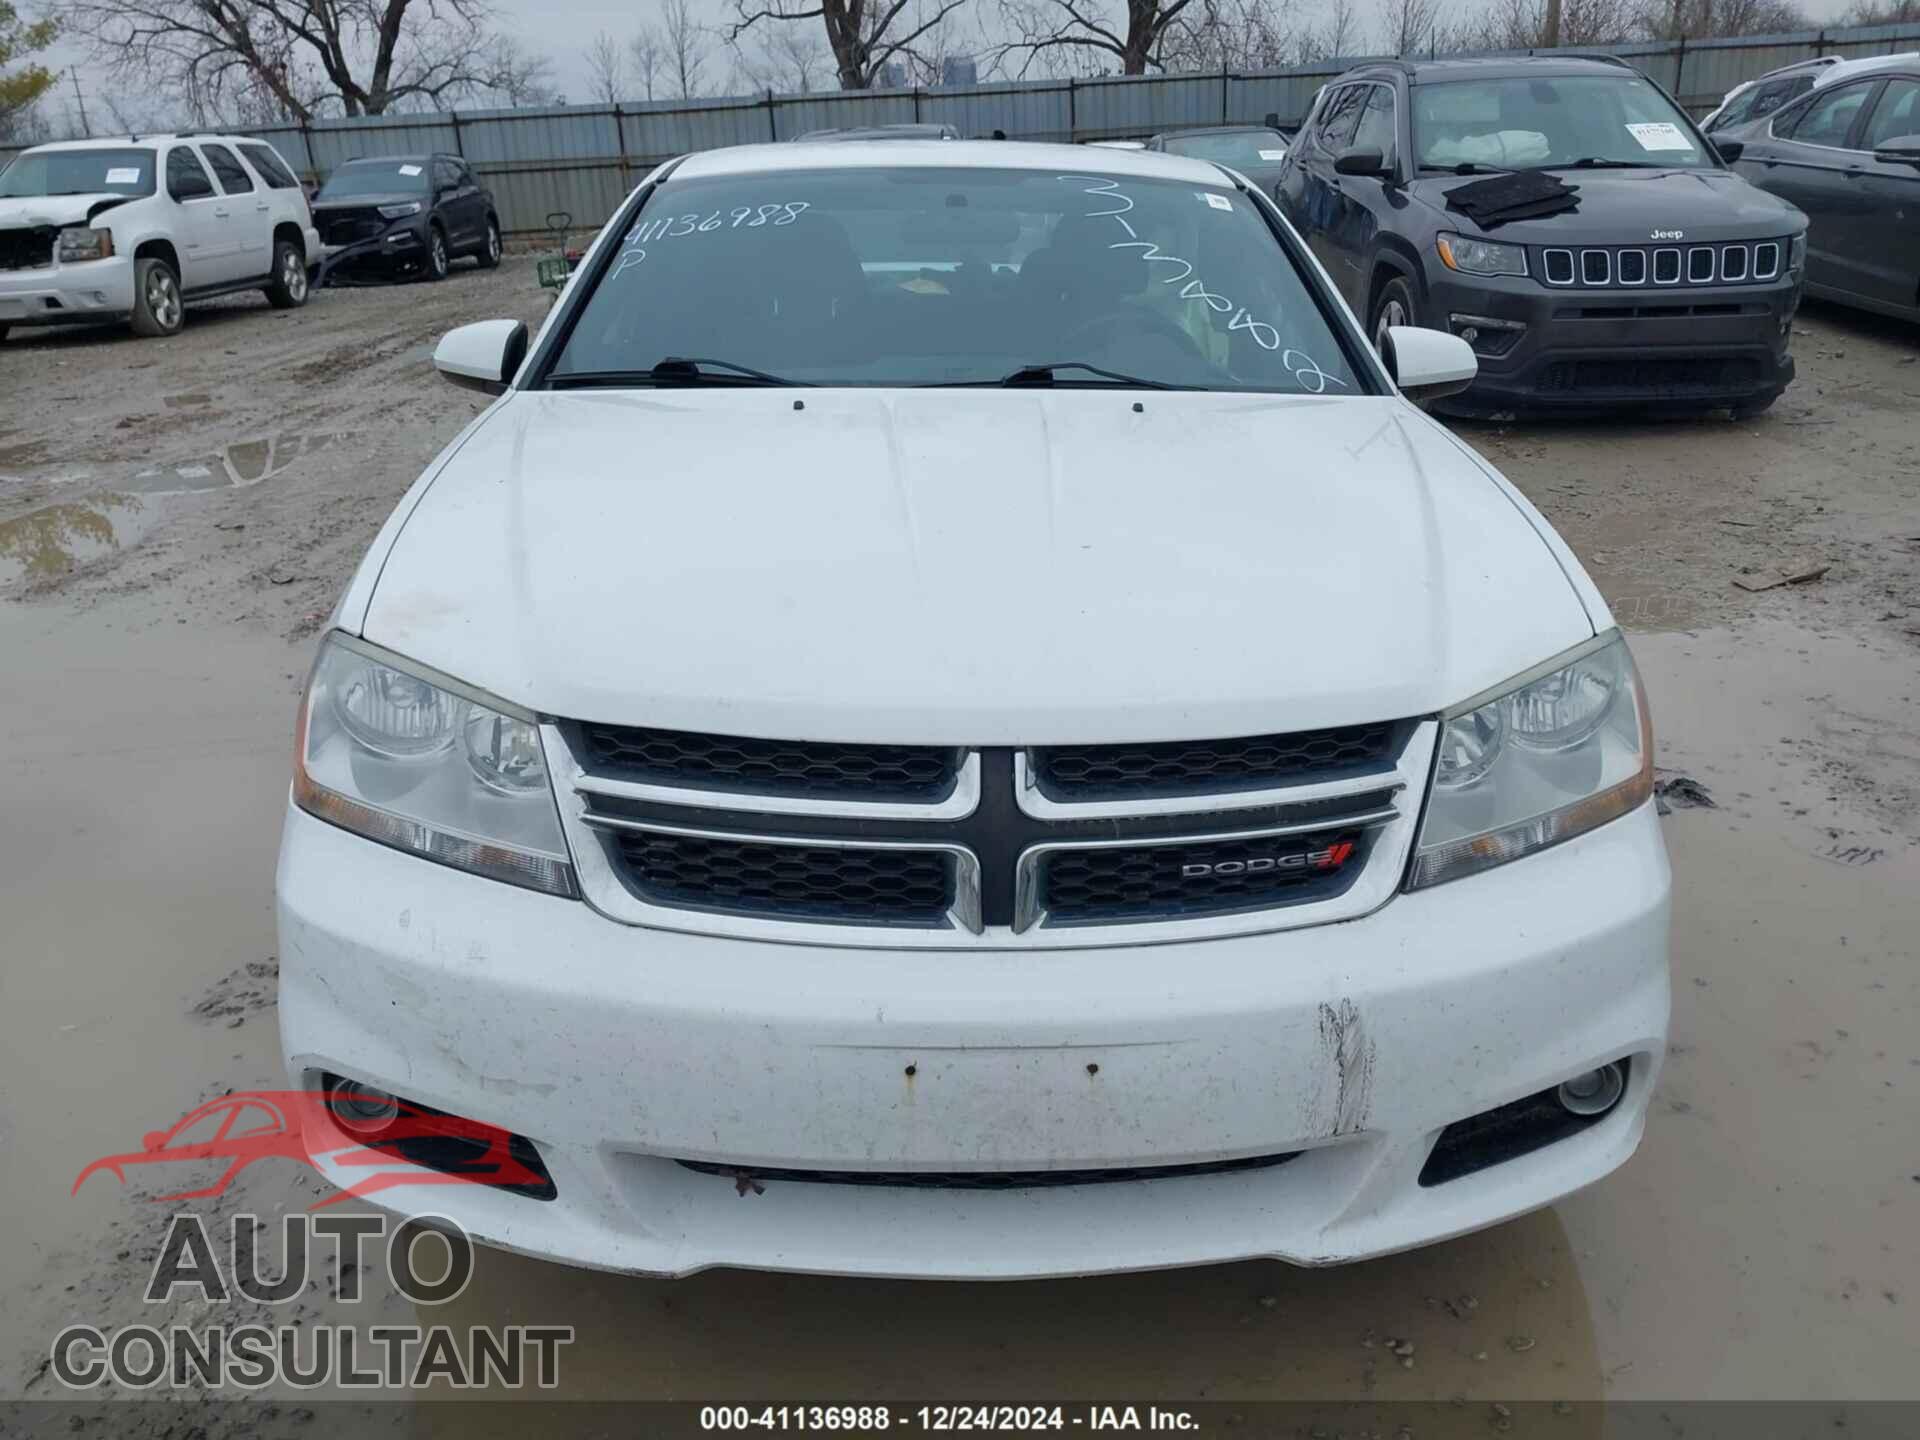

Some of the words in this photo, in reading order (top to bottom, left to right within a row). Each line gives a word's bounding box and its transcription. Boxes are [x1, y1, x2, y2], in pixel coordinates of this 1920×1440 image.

[624, 202, 811, 245] 41136988
[1650, 228, 1684, 240] Jeep
[611, 249, 646, 280] P
[1181, 849, 1332, 877] DODGE
